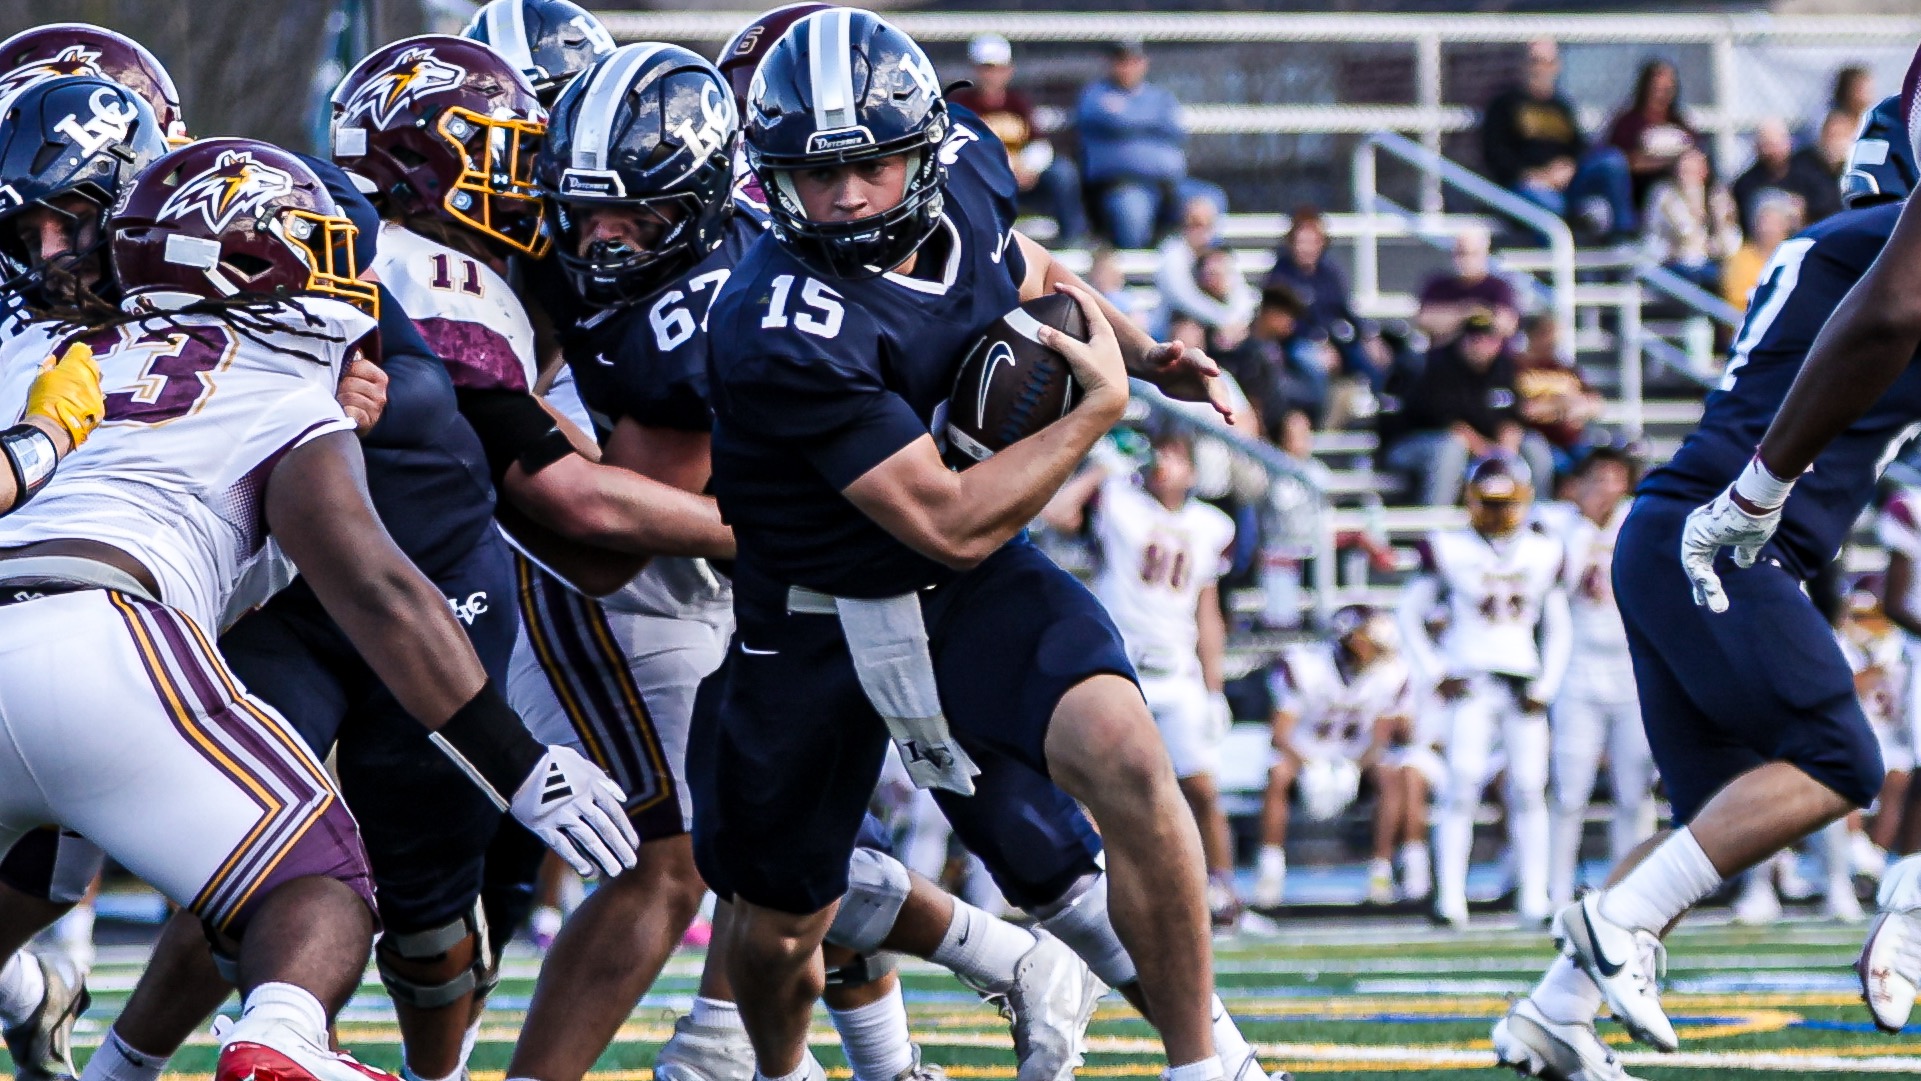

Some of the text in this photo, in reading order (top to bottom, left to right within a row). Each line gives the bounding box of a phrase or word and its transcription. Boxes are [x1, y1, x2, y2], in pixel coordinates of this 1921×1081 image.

[54, 87, 139, 159] LVC
[429, 252, 485, 298] 11
[761, 274, 845, 339] 15
[649, 268, 732, 352] 67
